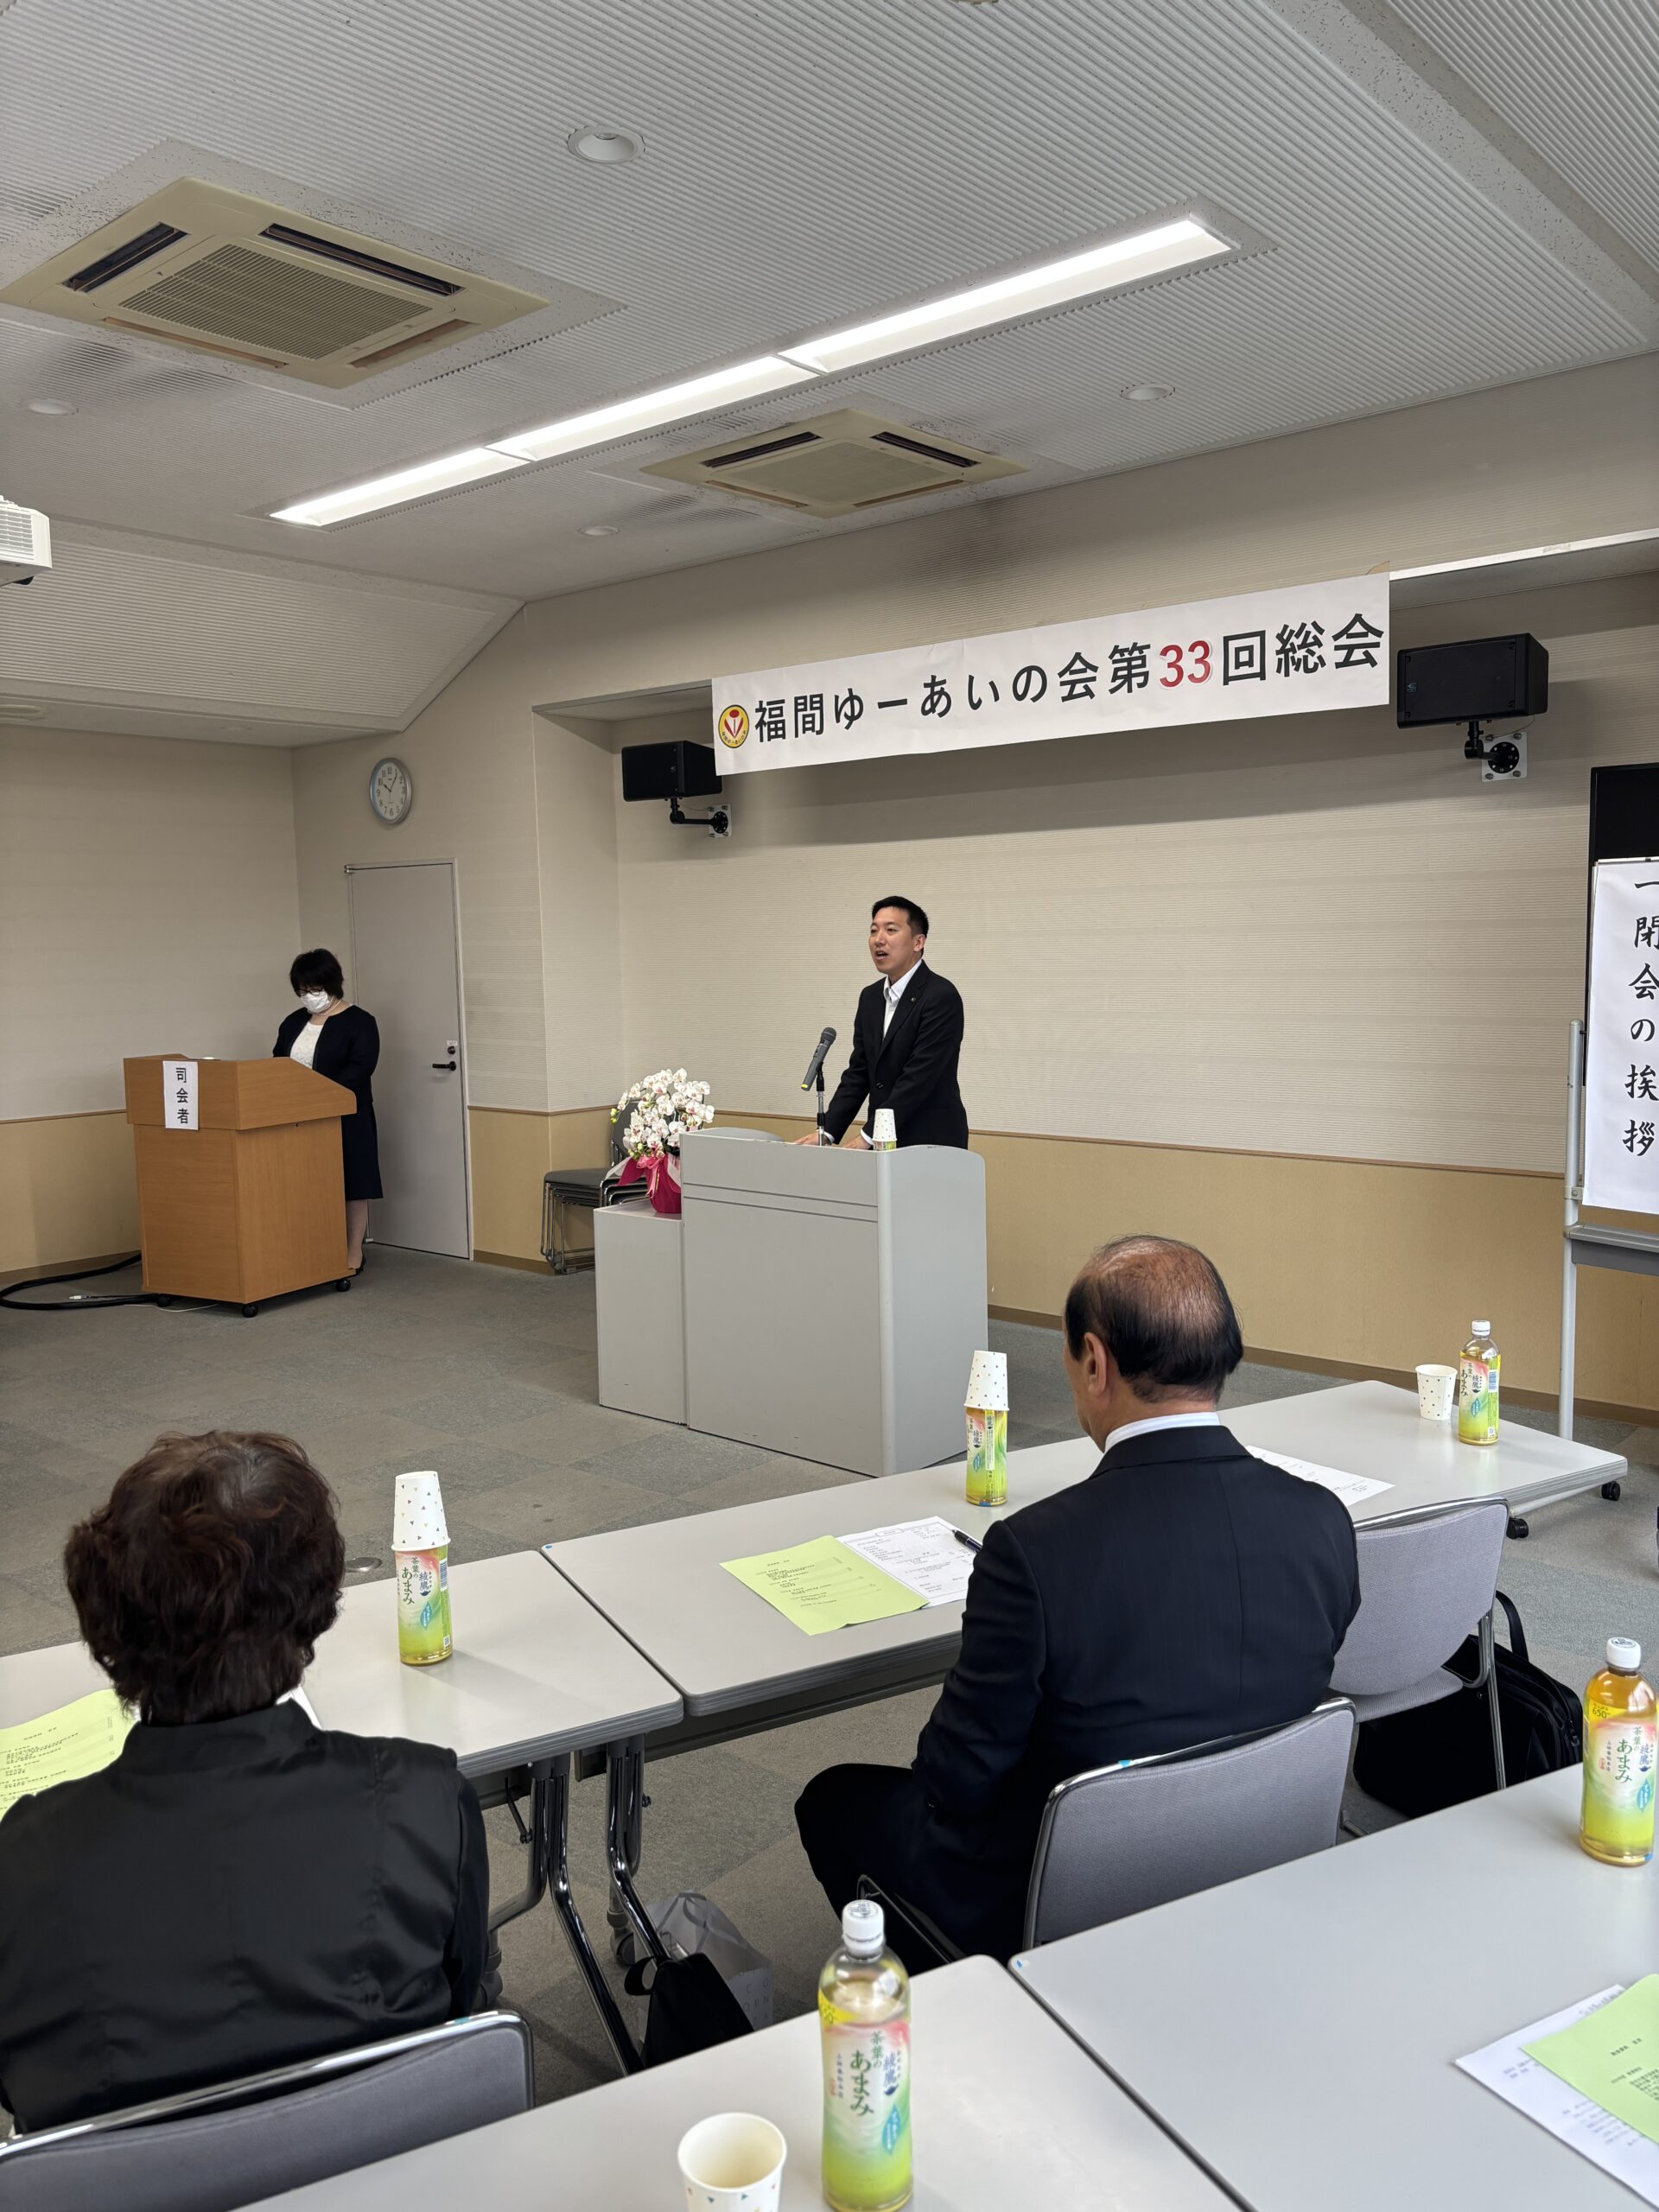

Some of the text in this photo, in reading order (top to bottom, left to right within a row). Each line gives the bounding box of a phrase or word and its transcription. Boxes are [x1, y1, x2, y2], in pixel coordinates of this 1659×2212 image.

[754, 613, 1384, 743] 福間ゆーあいの会第33回総会
[175, 1067, 189, 1124] 司会者
[402, 1567, 415, 1605] あまみ
[1615, 1738, 1632, 1783] あまみ
[850, 2050, 874, 2116] あまみ
